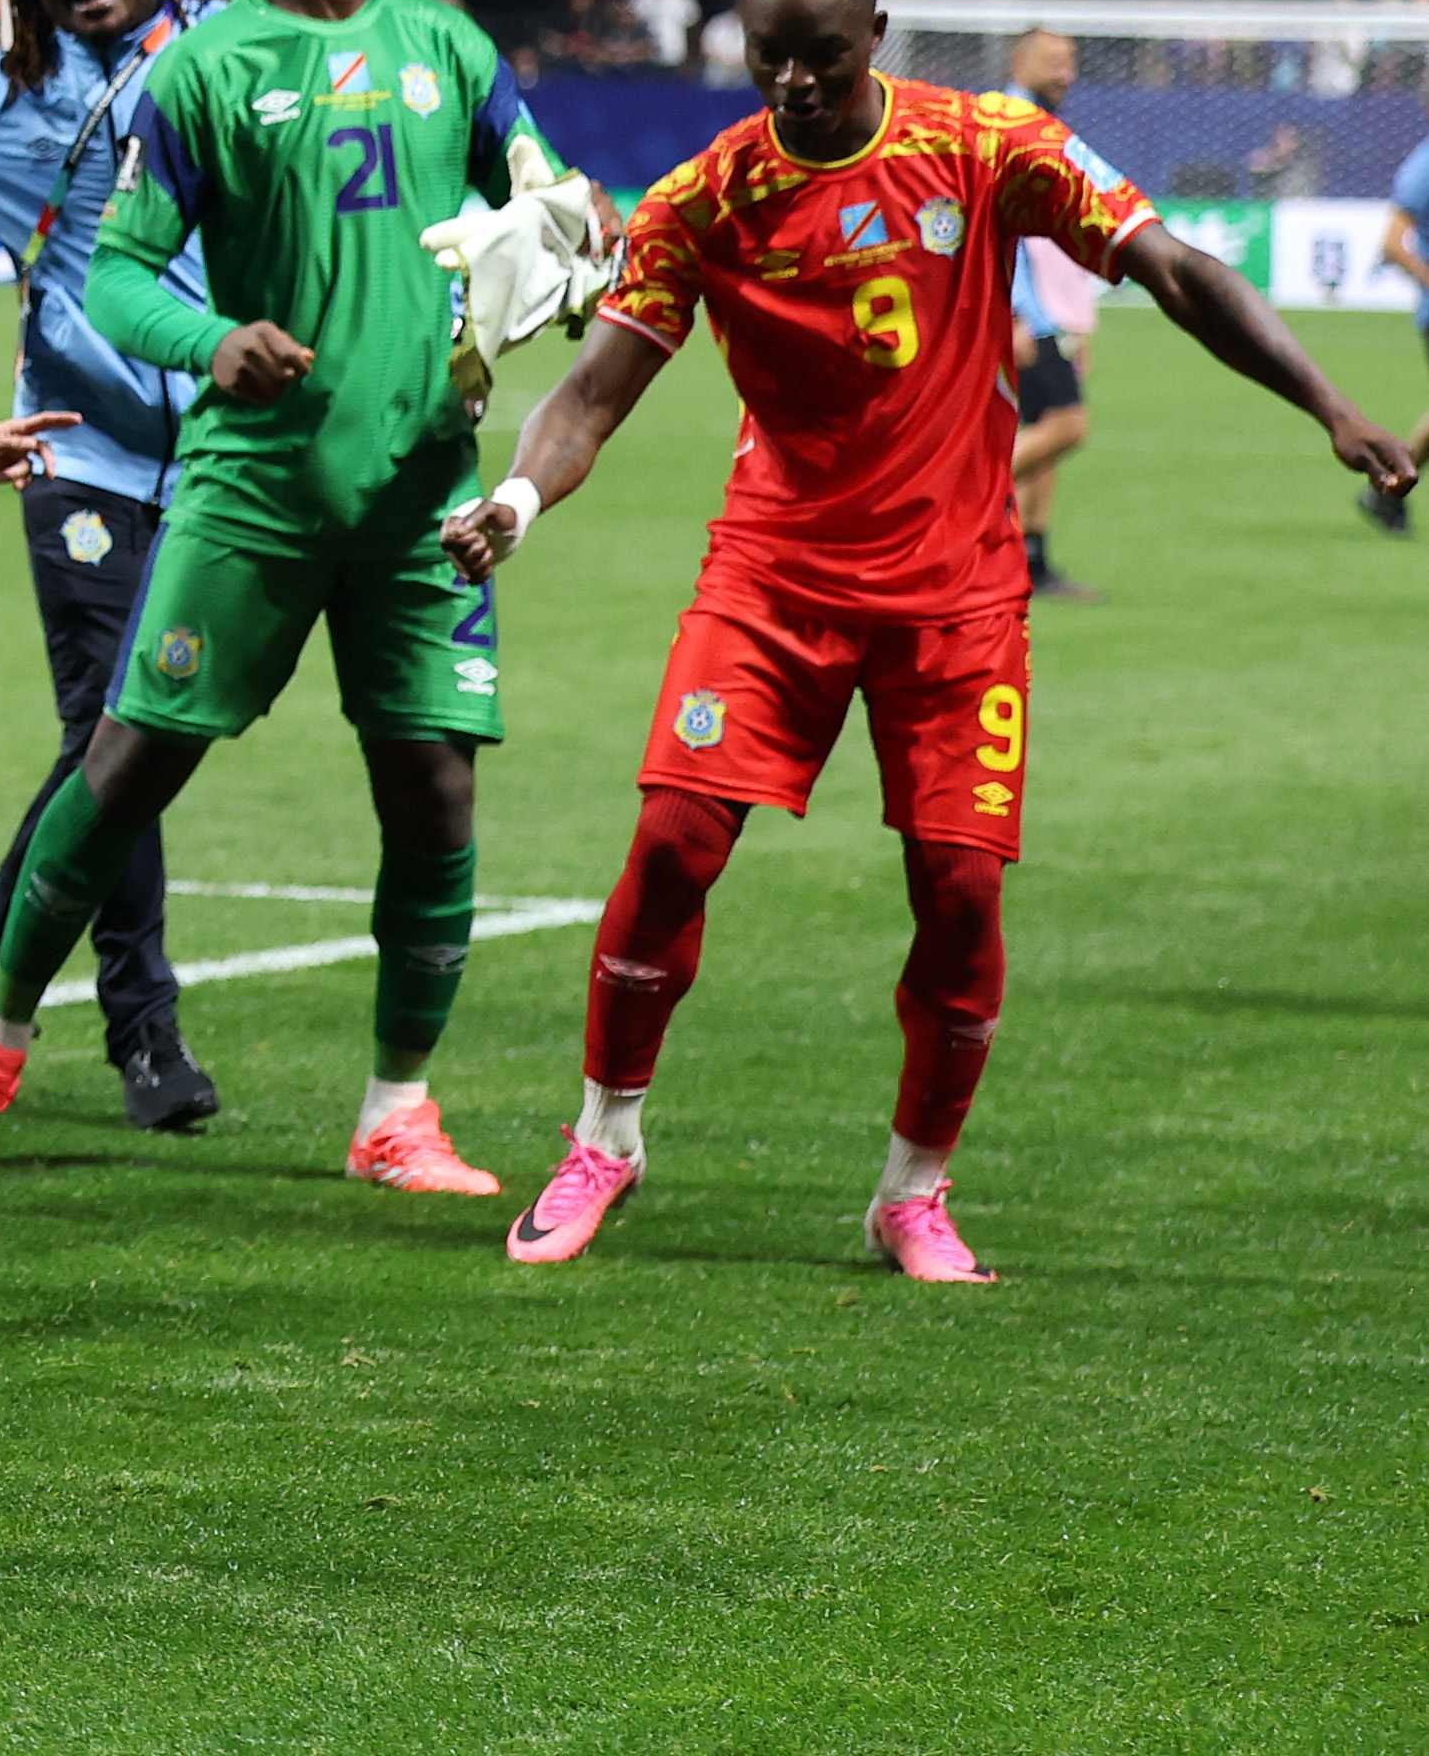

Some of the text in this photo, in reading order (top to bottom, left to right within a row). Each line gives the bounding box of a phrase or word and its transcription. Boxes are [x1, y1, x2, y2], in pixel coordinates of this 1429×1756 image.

[328, 124, 398, 212] 21
[853, 275, 919, 368] 9
[976, 684, 1023, 772] 9
